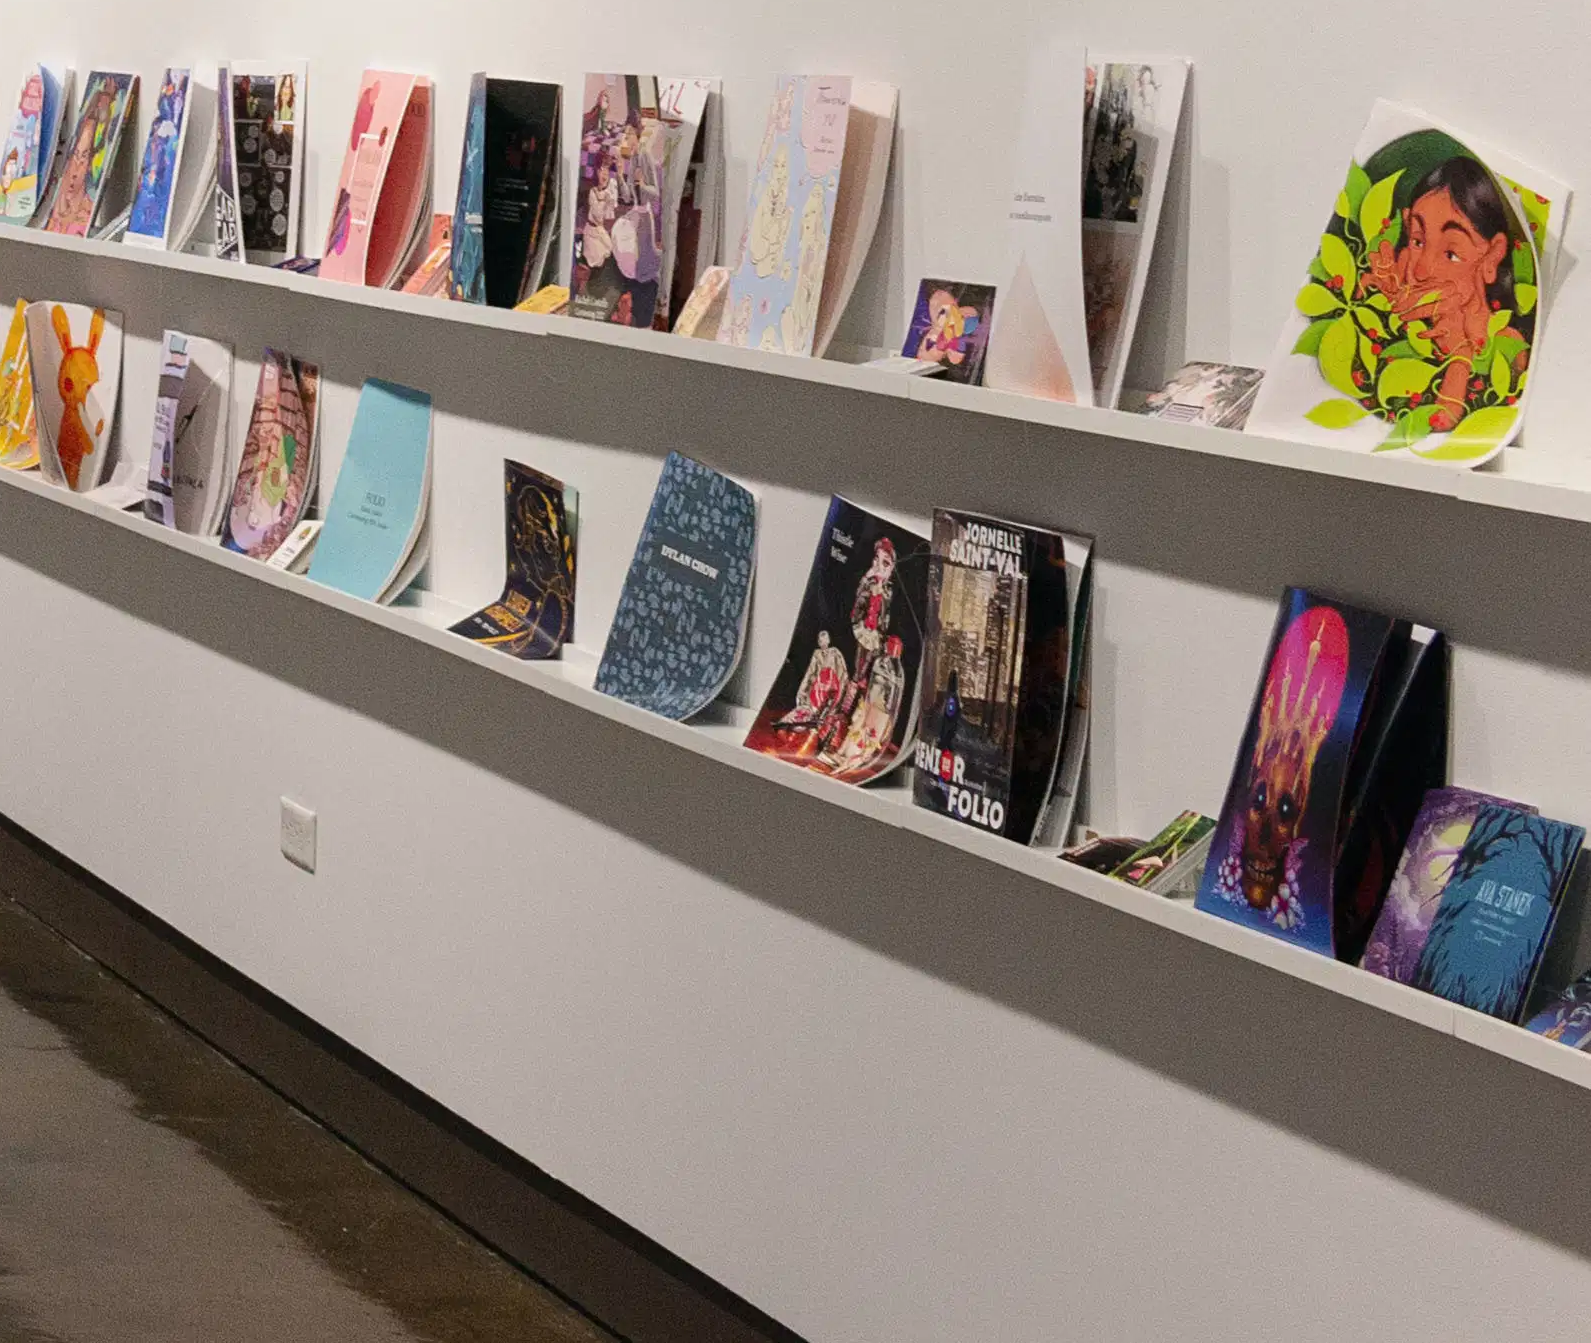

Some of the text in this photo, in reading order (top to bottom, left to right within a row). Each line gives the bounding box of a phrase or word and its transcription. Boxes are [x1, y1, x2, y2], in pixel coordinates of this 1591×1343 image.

[963, 520, 1023, 555] JORNELLE
[661, 544, 720, 579] DYLAN CHOW
[949, 538, 1028, 579] SAINT-VAL
[947, 784, 1004, 830] FOLIO
